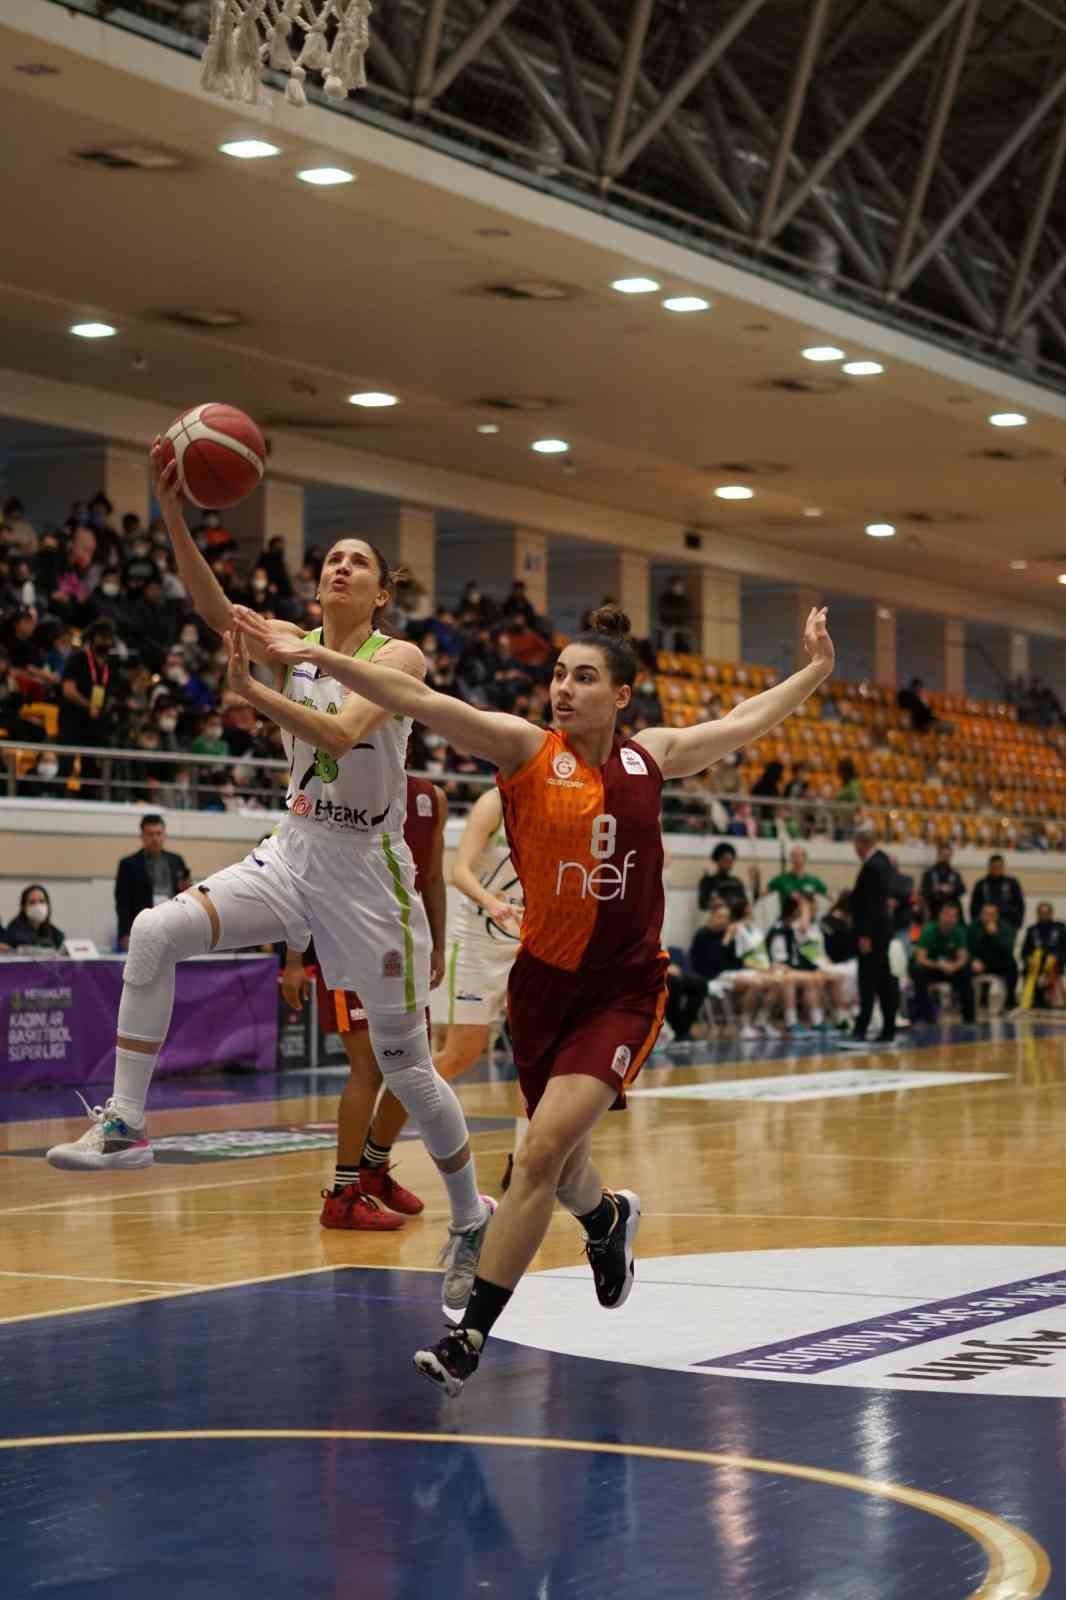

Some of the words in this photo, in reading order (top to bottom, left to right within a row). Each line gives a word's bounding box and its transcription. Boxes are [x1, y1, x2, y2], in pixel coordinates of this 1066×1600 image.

[590, 814, 617, 859] 8
[556, 849, 637, 901] nef
[885, 1308, 1006, 1338] Spor
[736, 1331, 908, 1370] Kulübü
